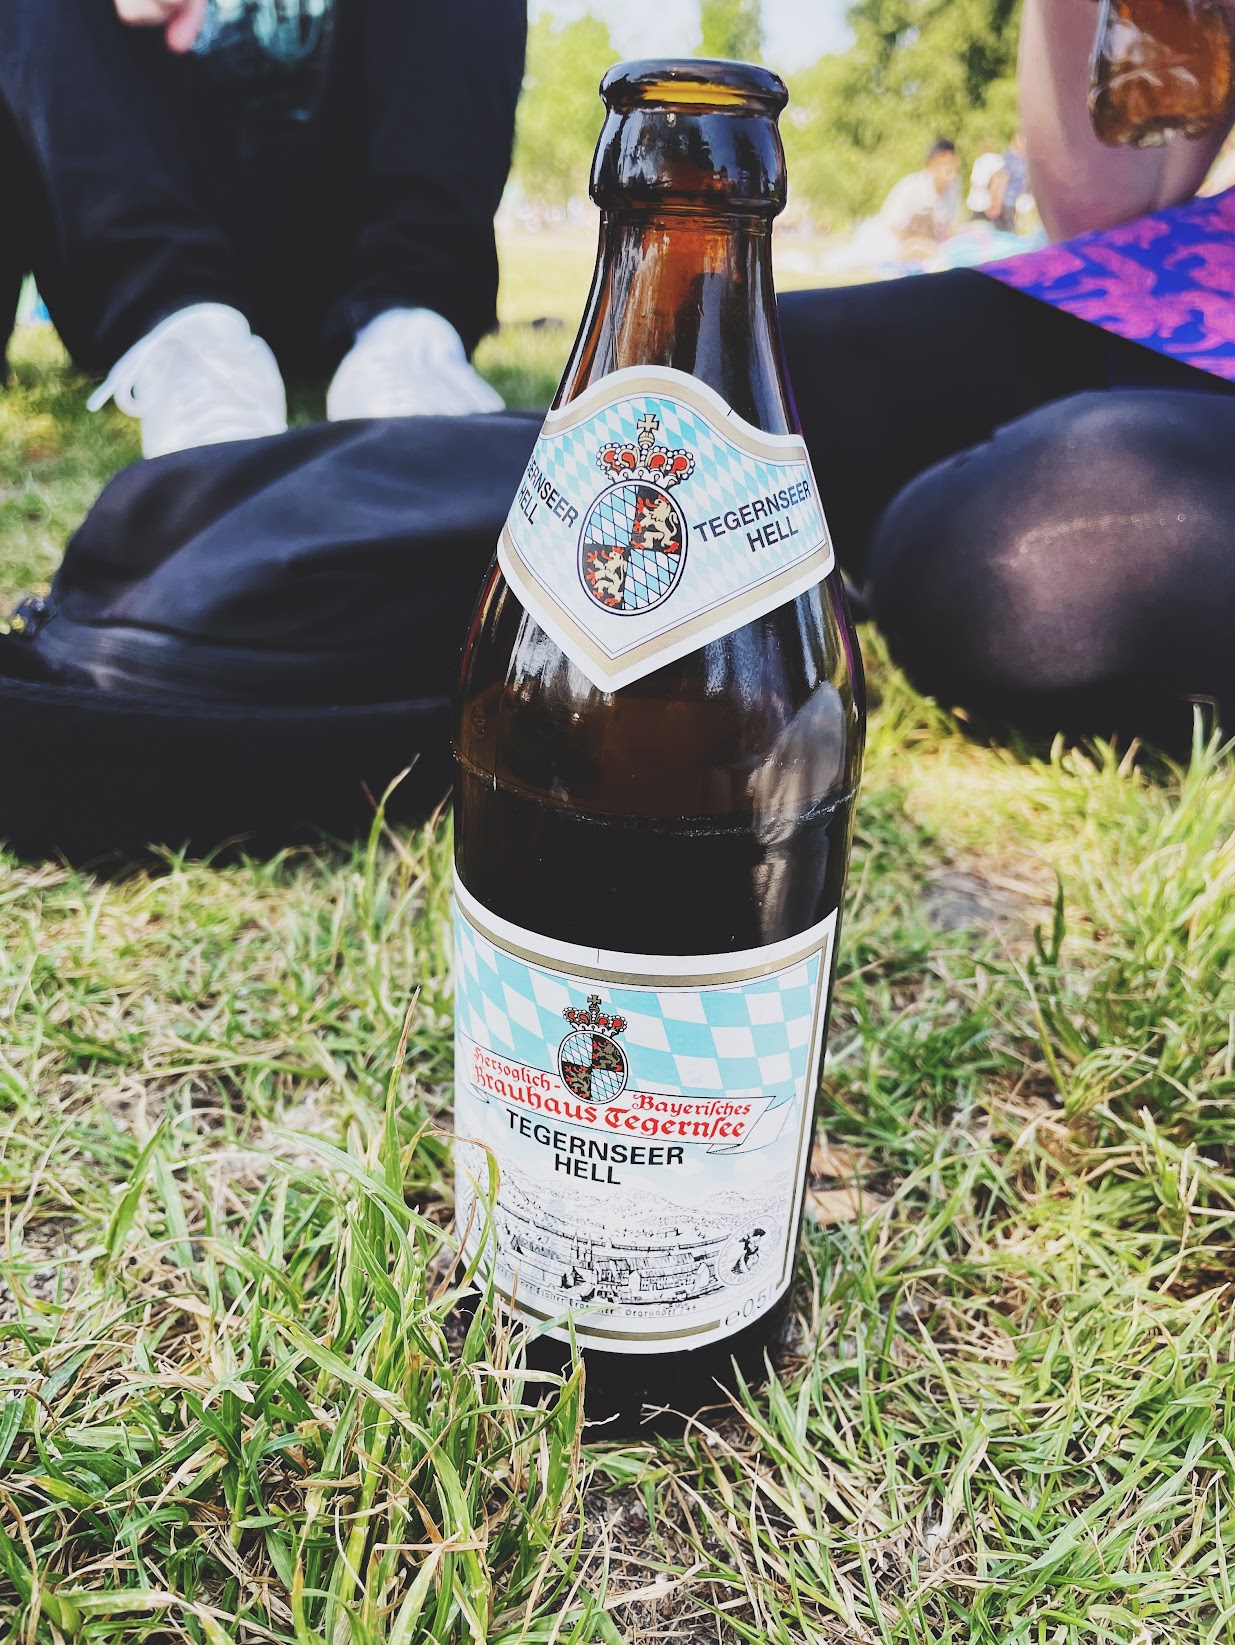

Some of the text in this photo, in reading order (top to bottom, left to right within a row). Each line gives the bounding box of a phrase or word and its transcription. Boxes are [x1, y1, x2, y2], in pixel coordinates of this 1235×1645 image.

[518, 482, 538, 525] HELL
[693, 480, 811, 542] TEGERNSEER
[746, 518, 799, 552] HELL
[473, 1066, 597, 1123] Brauhaus
[506, 1108, 684, 1166] TEGERNSEER
[555, 1153, 621, 1185] HELL
